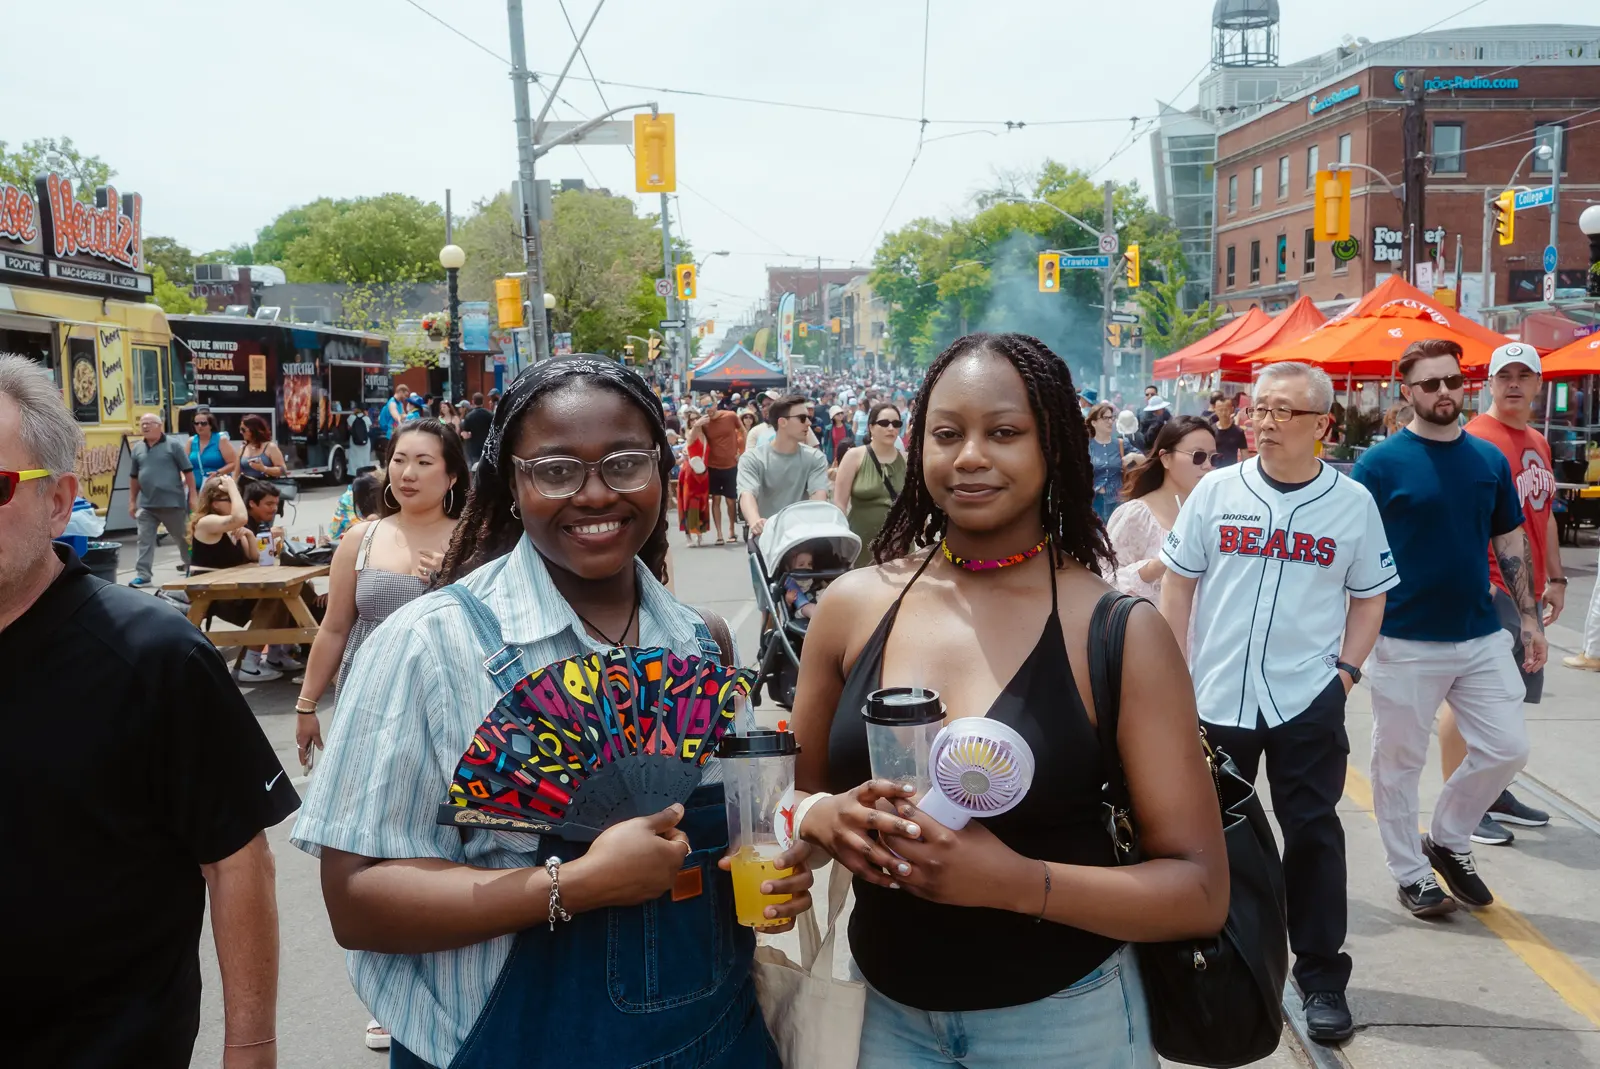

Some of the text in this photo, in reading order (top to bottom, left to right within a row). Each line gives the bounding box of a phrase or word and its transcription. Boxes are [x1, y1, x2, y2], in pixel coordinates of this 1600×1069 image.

[1518, 191, 1543, 205] College
[1374, 227, 1446, 243] Forer
[1061, 258, 1098, 266] Crawford
[188, 340, 238, 351] YOU'RE INVITED
[1219, 525, 1337, 569] BEARS
